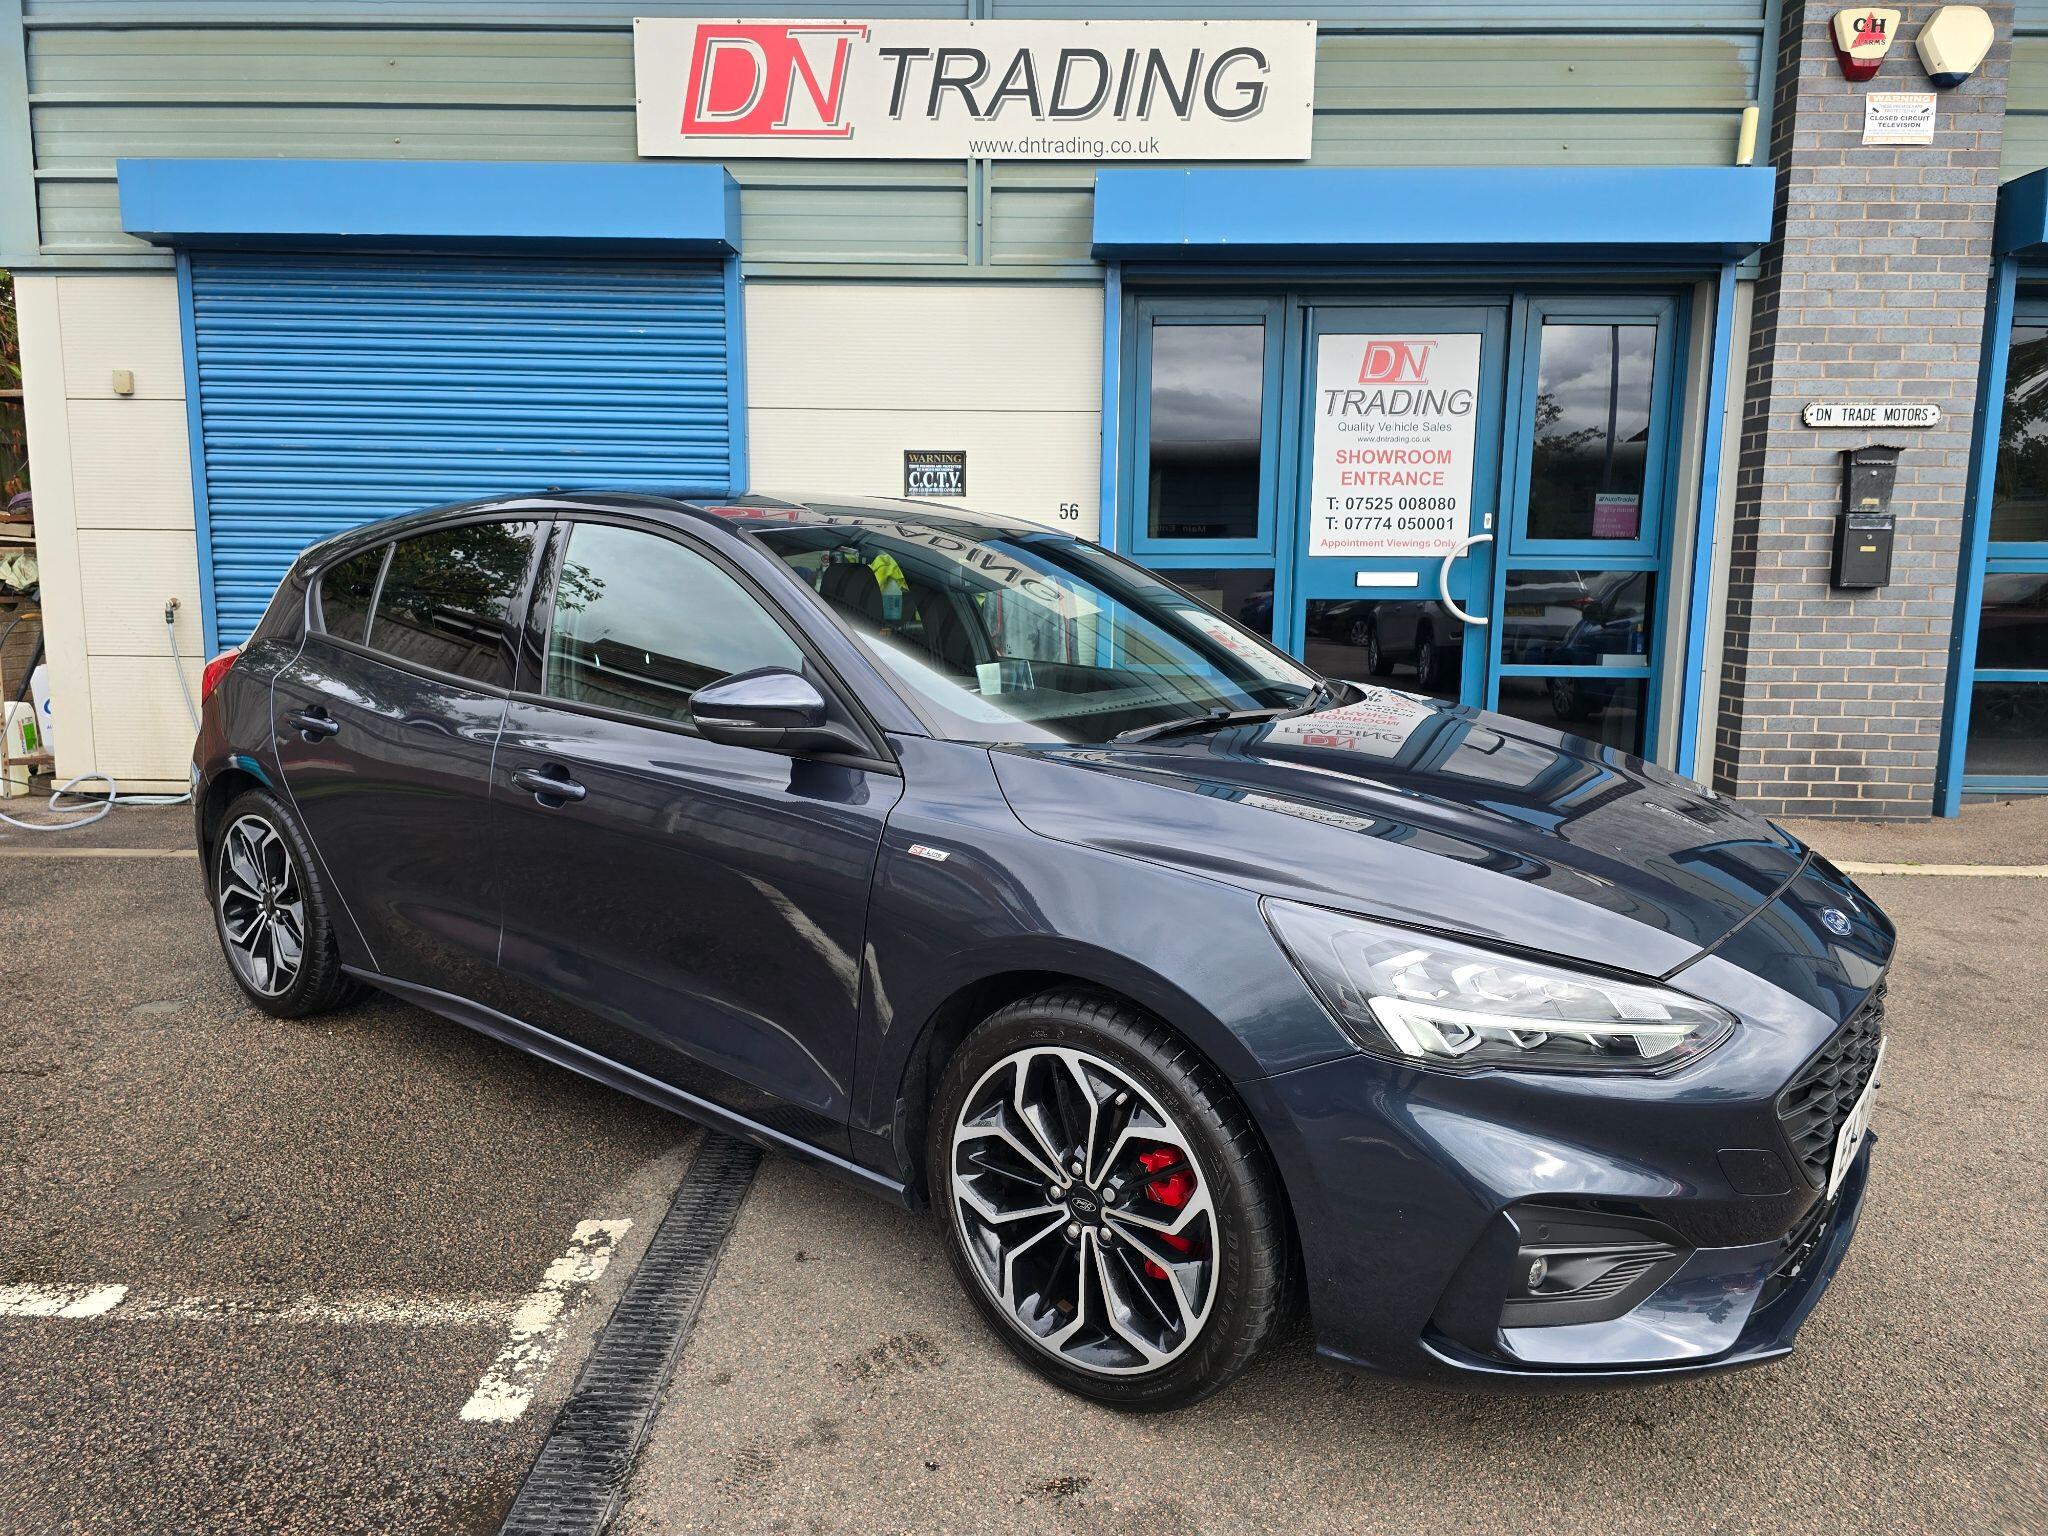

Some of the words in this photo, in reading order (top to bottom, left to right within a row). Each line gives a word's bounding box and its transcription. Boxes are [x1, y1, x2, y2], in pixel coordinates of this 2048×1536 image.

[683, 25, 870, 138] DN
[878, 47, 1270, 121] TRADING
[968, 136, 1160, 157] www.dntrading.co.uk
[1359, 341, 1438, 385] DN
[1324, 389, 1474, 416] TRADING
[1816, 408, 1832, 421] DN
[1842, 408, 1877, 421] TRADE
[1884, 408, 1929, 421] MOTORS
[1337, 422, 1374, 433] Quality
[1378, 422, 1419, 432] Vehicle
[1422, 422, 1452, 432] Sales
[1357, 435, 1431, 444] www.dntrading.co.uk
[908, 454, 962, 463] WARNING
[1336, 449, 1452, 465] SHOWROOM
[1341, 471, 1445, 486] ENTRANCE
[1326, 497, 1339, 510] T:
[1345, 497, 1393, 510] 07525
[1399, 497, 1456, 510] 008080
[1059, 503, 1079, 520] 56
[1325, 517, 1338, 530] T:
[1344, 517, 1392, 530] 07774
[1397, 517, 1455, 530] 050001
[1320, 538, 1384, 549] Appointment
[1386, 538, 1431, 549] Viewings
[1433, 538, 1457, 549] Only
[1076, 1199, 1093, 1211] Ford
